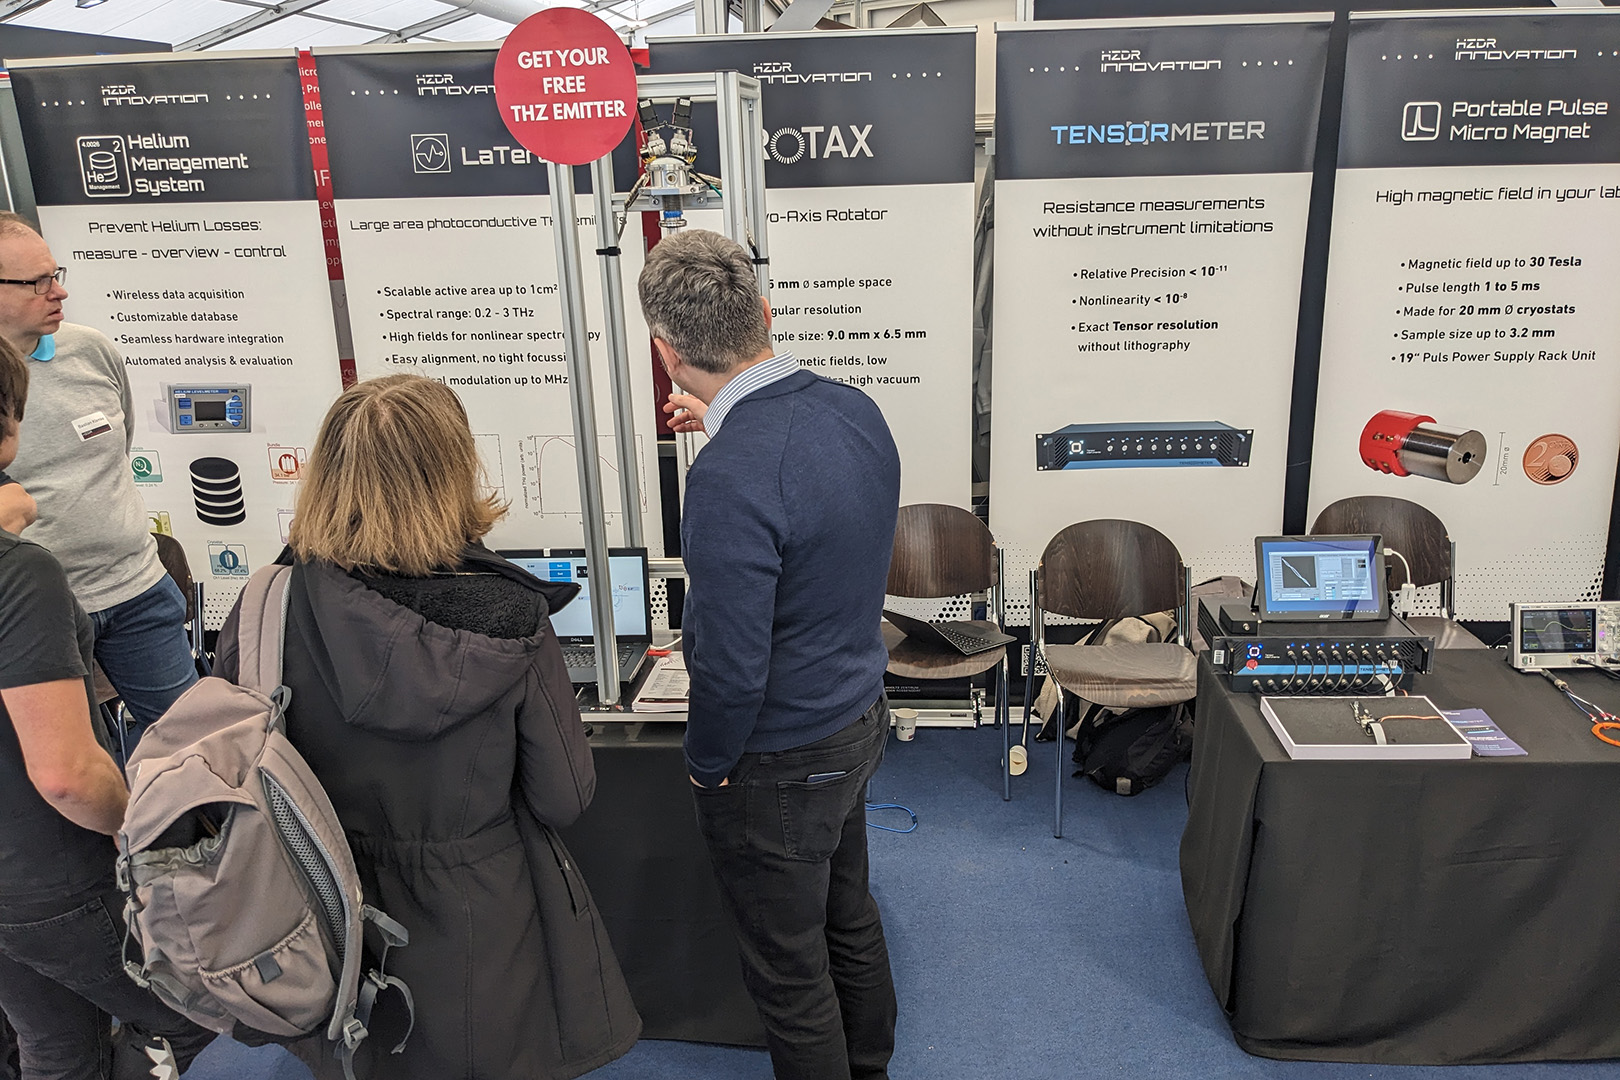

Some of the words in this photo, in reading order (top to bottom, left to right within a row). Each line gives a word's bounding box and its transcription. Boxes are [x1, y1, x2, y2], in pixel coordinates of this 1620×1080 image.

[1456, 39, 1496, 48] HZDR
[518, 51, 553, 68] GET
[556, 47, 610, 66] YOUR
[1102, 50, 1140, 60] HZDR
[1455, 50, 1576, 60] INNOVATION
[754, 63, 792, 73] HZDR
[1101, 58, 1221, 72] INNOVATION
[416, 74, 453, 84] HZDR
[543, 76, 586, 94] FREE
[101, 85, 136, 95] HZDR
[418, 85, 497, 97] INNOVAT
[102, 92, 208, 106] INNOVATION
[511, 104, 548, 121] THZ
[553, 100, 627, 120] EMITTER
[1452, 100, 1542, 117] Portable
[1548, 99, 1608, 115] Pulse
[1051, 121, 1265, 145] TENSORMETER
[1450, 124, 1507, 140] Micro
[1513, 122, 1590, 143] Magnet
[111, 139, 122, 154] 2
[128, 133, 189, 149] Helium
[131, 153, 248, 174] Management
[85, 169, 106, 184] He
[135, 177, 204, 196] System
[1376, 190, 1413, 205] High
[1418, 188, 1493, 204] magnetic
[1498, 187, 1533, 199] field
[1538, 187, 1551, 199] in
[1556, 189, 1595, 202] your
[1044, 201, 1135, 214] Resistance
[1140, 197, 1264, 211] measurements
[827, 208, 888, 221] Rotator
[89, 221, 148, 233] Prevent
[151, 220, 200, 232] Helium
[203, 220, 261, 231] Losses:
[350, 221, 389, 232] Large
[393, 221, 423, 229] area
[427, 217, 537, 231] photoconductive
[1033, 224, 1093, 237] without
[1098, 222, 1186, 235] instrument
[1191, 220, 1273, 233] limitations
[73, 250, 137, 259] measure
[152, 246, 219, 258] overview
[234, 245, 286, 257] control
[1409, 258, 1461, 271] Magnetic
[1466, 258, 1492, 268] field
[1496, 260, 1510, 269] up
[1515, 258, 1525, 267] to
[1530, 257, 1544, 267] 30
[1549, 256, 1581, 266] Tesla
[1081, 269, 1127, 279] Relative
[1131, 267, 1185, 277] Precision
[814, 278, 855, 289] sample
[859, 279, 891, 289] space
[1406, 283, 1439, 293] Pulse
[1443, 282, 1480, 294] length
[1495, 282, 1506, 291] to
[1511, 281, 1518, 291] 5
[113, 290, 159, 299] Wireless
[163, 290, 185, 299] data
[188, 289, 244, 301] acquisition
[384, 287, 431, 296] Scalable
[435, 286, 467, 295] active
[499, 287, 512, 296] up
[516, 286, 526, 294] to
[1080, 295, 1150, 306] Nonlinearity
[117, 312, 187, 322] Customizable
[191, 312, 238, 321] database
[387, 309, 433, 321] Spectral
[437, 311, 471, 320] range:
[475, 308, 491, 318] 0.2
[503, 308, 509, 317] 3
[512, 308, 534, 317] THz
[771, 306, 800, 318] gular
[805, 304, 861, 314] resolution
[1404, 306, 1434, 316] Made
[1439, 306, 1456, 315] for
[1459, 305, 1474, 315] 20
[1478, 307, 1500, 315] mm
[1517, 305, 1575, 316] cryostats
[1079, 322, 1109, 332] Exact
[1113, 321, 1153, 331] Tensor
[1157, 320, 1218, 330] resolution
[121, 334, 172, 344] Seamless
[175, 334, 224, 343] hardware
[228, 334, 283, 345] integration
[390, 332, 414, 344] High
[418, 332, 448, 341] fields
[452, 331, 467, 340] for
[471, 331, 523, 340] nonlinear
[527, 328, 600, 344] spectrpy
[799, 331, 823, 340] size:
[827, 330, 844, 340] 9.0
[884, 329, 901, 339] 6.5
[1401, 329, 1445, 341] Sample
[1449, 329, 1472, 339] size
[1477, 331, 1490, 340] up
[1495, 329, 1505, 338] to
[1510, 328, 1528, 338] 3.2
[1078, 342, 1120, 352] without
[1124, 340, 1190, 352] lithography
[124, 356, 181, 368] Automated
[185, 356, 226, 367] analysis
[230, 356, 237, 365] &
[240, 356, 292, 365] evaluation
[392, 355, 417, 365] Easy
[422, 354, 479, 365] alignment,
[499, 353, 523, 364] tight
[527, 352, 566, 362] focussi
[797, 356, 826, 366] netic
[830, 356, 863, 366] fields,
[868, 355, 887, 365] low
[1423, 353, 1448, 362] Puls
[1452, 352, 1490, 361] Power
[1494, 351, 1535, 363] Supply
[1539, 351, 1567, 360] Rack
[1572, 351, 1595, 360] Unit
[450, 375, 511, 385] modulation
[515, 377, 527, 386] up
[531, 376, 541, 384] to
[545, 375, 568, 384] MHz
[877, 376, 920, 384] vacuum
